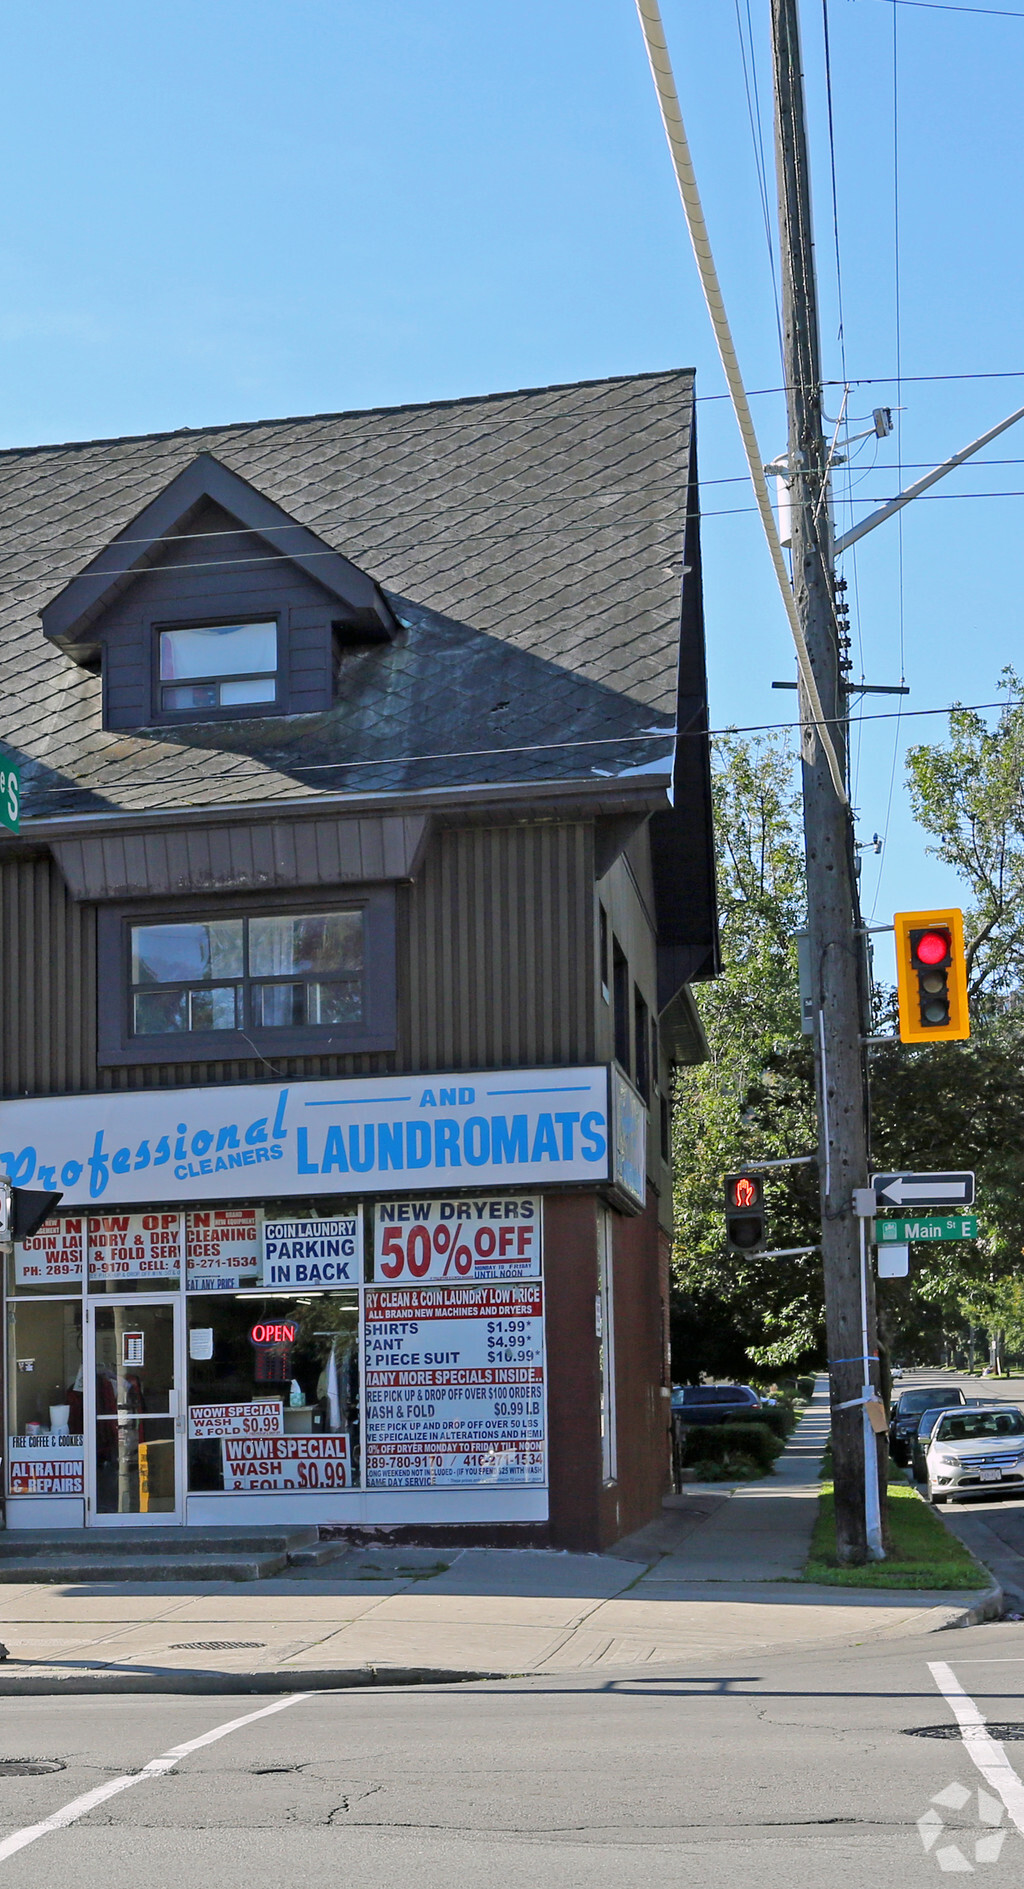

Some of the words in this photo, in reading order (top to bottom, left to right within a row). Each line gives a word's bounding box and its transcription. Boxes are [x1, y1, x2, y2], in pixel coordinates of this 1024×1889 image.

[7, 772, 18, 821] S
[419, 1087, 475, 1107] AND
[297, 1110, 606, 1174] LAUNDROMATS
[174, 1144, 283, 1180] CLEANERS
[380, 1202, 432, 1222] NEW
[440, 1200, 534, 1220] DRYERS
[65, 1216, 131, 1234] NOW
[267, 1224, 296, 1239] COIN
[298, 1221, 355, 1237] LAUNDRY
[904, 1223, 942, 1239] Main
[946, 1220, 956, 1230] St
[961, 1221, 971, 1237] E
[23, 1236, 57, 1251] COIN
[62, 1233, 127, 1249] LAUNDRY
[134, 1234, 144, 1246] &
[150, 1230, 180, 1245] DRY
[186, 1227, 257, 1243] CLEANING
[94, 1250, 105, 1261] &
[111, 1247, 145, 1261] FOLD
[266, 1238, 355, 1260] PARKING
[380, 1223, 473, 1279] 50%
[474, 1225, 534, 1258] OFF
[23, 1266, 42, 1277] PH:
[139, 1260, 169, 1271] CELL:
[271, 1265, 291, 1283] IN
[295, 1262, 350, 1282] BACK
[475, 1271, 498, 1279] UNTIL
[500, 1270, 523, 1278] NOON
[201, 1278, 214, 1290] ANY
[217, 1278, 235, 1289] PRICE
[380, 1291, 410, 1308] CLEAN
[411, 1291, 419, 1306] &
[420, 1290, 443, 1306] COIN
[444, 1289, 488, 1306] LAUNDRY
[490, 1288, 511, 1304] LOW
[368, 1310, 384, 1319] ALL
[385, 1309, 413, 1319] BRAND
[414, 1308, 434, 1318] NEW
[435, 1307, 479, 1317] MACHINES
[479, 1306, 498, 1316] AND
[498, 1305, 533, 1315] DRYERS
[250, 1324, 295, 1342] OPEN
[365, 1322, 419, 1336] SHIRTS
[365, 1338, 404, 1351] PANT
[365, 1354, 372, 1367] 2
[375, 1353, 420, 1366] PIECE
[424, 1351, 460, 1365] SUIT
[366, 1372, 397, 1387] MANY
[399, 1370, 433, 1385] MORE
[435, 1369, 493, 1384] SPECIALS
[367, 1390, 383, 1403] REE
[384, 1389, 403, 1402] PICK
[404, 1389, 416, 1401] UP
[417, 1389, 423, 1401] &
[424, 1388, 447, 1401] DROP
[448, 1387, 464, 1401] OFF
[464, 1387, 487, 1400] OVER
[488, 1386, 508, 1399] $100
[509, 1386, 542, 1399] ORDERS
[192, 1407, 226, 1419] WOW!
[228, 1405, 279, 1417] SPECIAL
[396, 1405, 404, 1419] &
[407, 1404, 435, 1418] FOLD
[494, 1401, 524, 1417] $0.99
[194, 1418, 232, 1427] WASH
[243, 1417, 279, 1434] $0.99
[194, 1428, 204, 1437] &
[207, 1427, 241, 1436] FOLD
[387, 1422, 408, 1431] PICK
[409, 1422, 422, 1431] UP
[422, 1421, 441, 1430] AND
[442, 1421, 466, 1430] DROP
[467, 1420, 484, 1429] OFF
[484, 1420, 509, 1429] OVER
[510, 1420, 521, 1428] 50
[522, 1419, 539, 1428] LBS
[12, 1436, 27, 1449] FREE
[28, 1435, 50, 1448] COFFEE
[51, 1435, 57, 1447] &
[58, 1435, 84, 1447] COOKIES
[379, 1432, 428, 1441] SPEICALIZE
[429, 1432, 438, 1440] IN
[440, 1430, 499, 1440] ALTERATIONS
[500, 1430, 519, 1439] AND
[227, 1440, 274, 1459] WOW!
[277, 1439, 345, 1458] SPECIAL
[380, 1444, 396, 1454] OFF
[397, 1443, 423, 1453] DRYER
[424, 1443, 458, 1453] MONDAY
[459, 1442, 470, 1452] TO
[471, 1442, 500, 1452] FRIDAY
[501, 1441, 517, 1451] TILL
[519, 1441, 542, 1451] NOON
[12, 1461, 83, 1477] ALTRATION
[366, 1455, 443, 1469] 289-780-9170
[463, 1453, 543, 1467] 416-271-1534
[230, 1461, 282, 1476] WASH
[297, 1461, 346, 1489] $0.99
[383, 1469, 411, 1478] WEEKEND
[411, 1468, 424, 1477] NOT
[424, 1468, 453, 1476] INCLUDED
[465, 1467, 478, 1476] YOU
[509, 1466, 525, 1475] WITH
[13, 1479, 23, 1492] &
[28, 1478, 83, 1493] REPAIRS
[233, 1480, 243, 1490] &
[250, 1479, 295, 1490] FOLD
[388, 1477, 404, 1487] DAY
[404, 1477, 437, 1486] SERVICE
